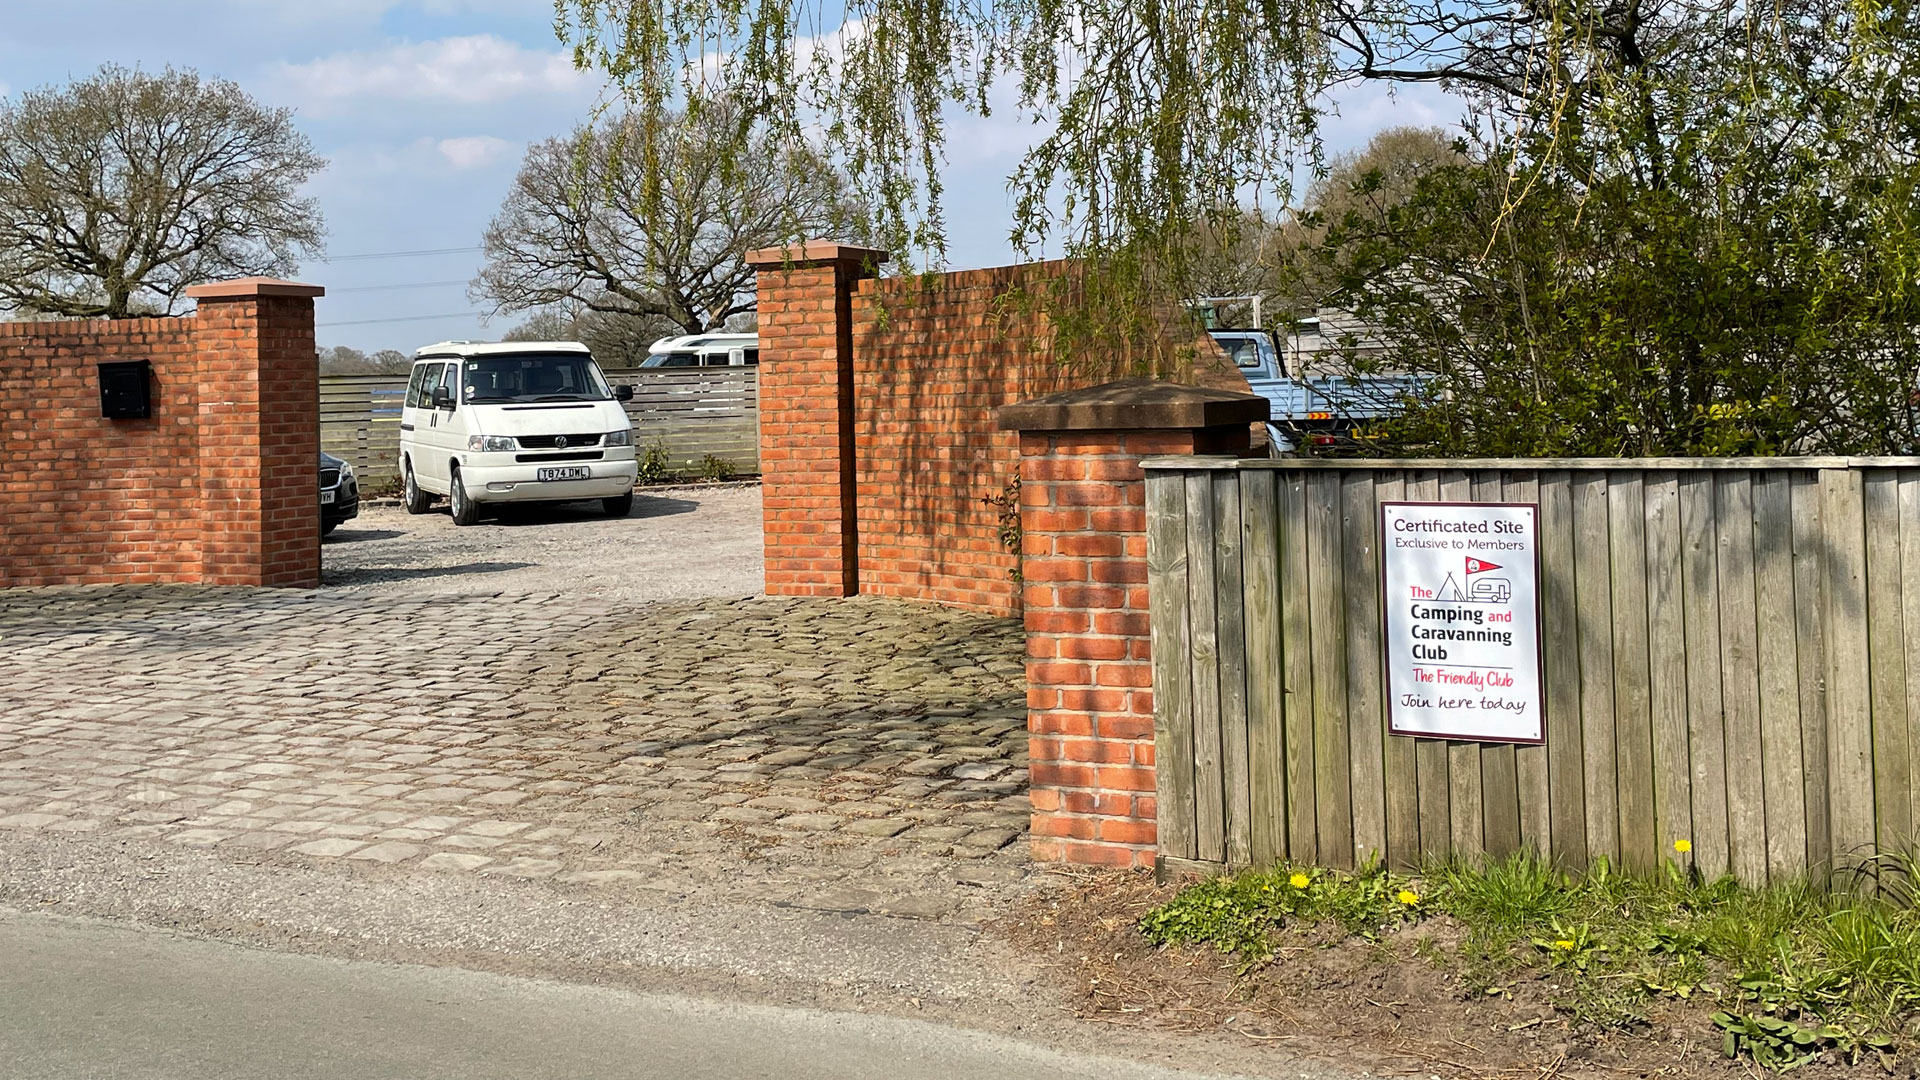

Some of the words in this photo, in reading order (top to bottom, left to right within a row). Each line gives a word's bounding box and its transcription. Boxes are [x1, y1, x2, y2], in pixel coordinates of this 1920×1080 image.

[542, 468, 566, 478] T874
[1394, 518, 1488, 534] Certificated
[1494, 520, 1524, 534] Site
[1395, 537, 1448, 549] Exclusive
[1452, 540, 1464, 549] to
[1467, 539, 1525, 551] Members
[1410, 586, 1433, 598] The
[1411, 604, 1484, 625] Camping
[1488, 611, 1512, 623] and
[1411, 624, 1512, 646] Caravanning
[1412, 644, 1448, 660] Club
[1412, 668, 1434, 683] The
[1437, 669, 1484, 692] Friendly
[1486, 671, 1514, 687] Club
[1401, 693, 1434, 708] Join
[1438, 696, 1476, 709] here
[1480, 696, 1526, 715] today
